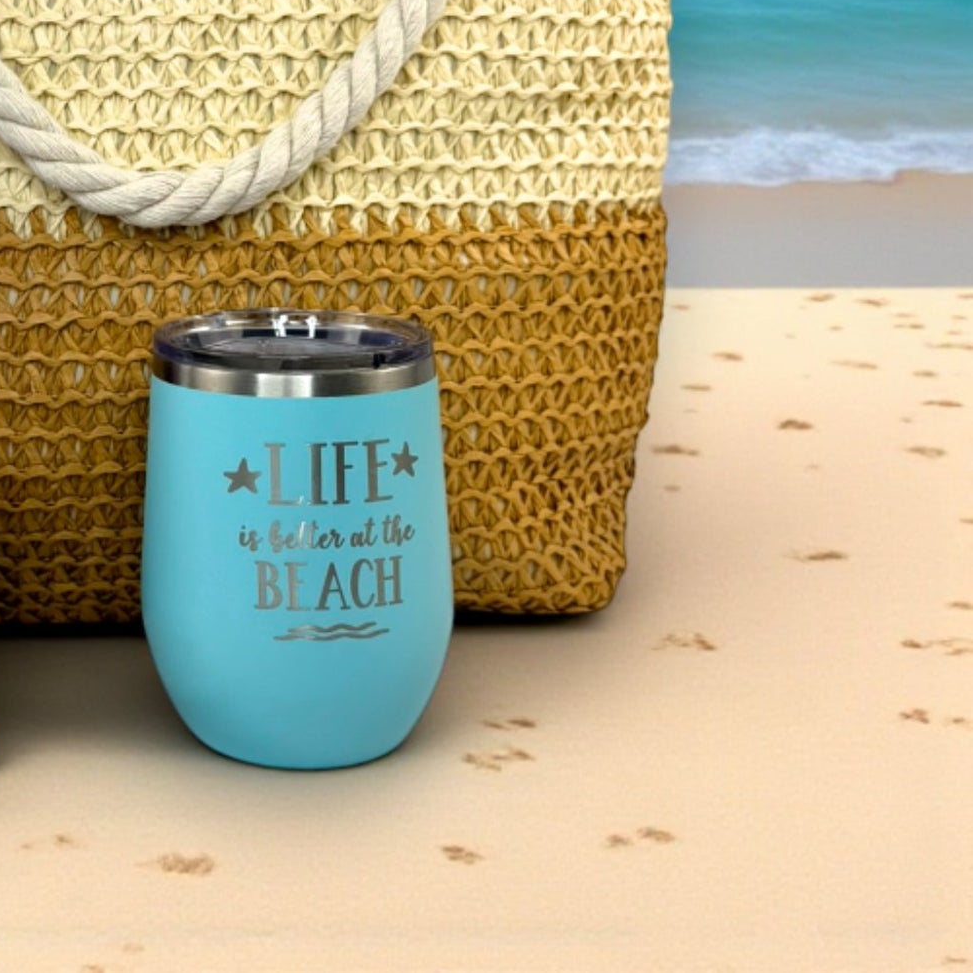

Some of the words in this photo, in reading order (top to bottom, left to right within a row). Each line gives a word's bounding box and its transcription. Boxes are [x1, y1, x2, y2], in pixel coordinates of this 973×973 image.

[264, 438, 393, 506] LIFE
[239, 525, 262, 552] is
[268, 520, 345, 553] better
[350, 517, 377, 548] at
[382, 514, 416, 546] the
[254, 555, 403, 611] BEACH
